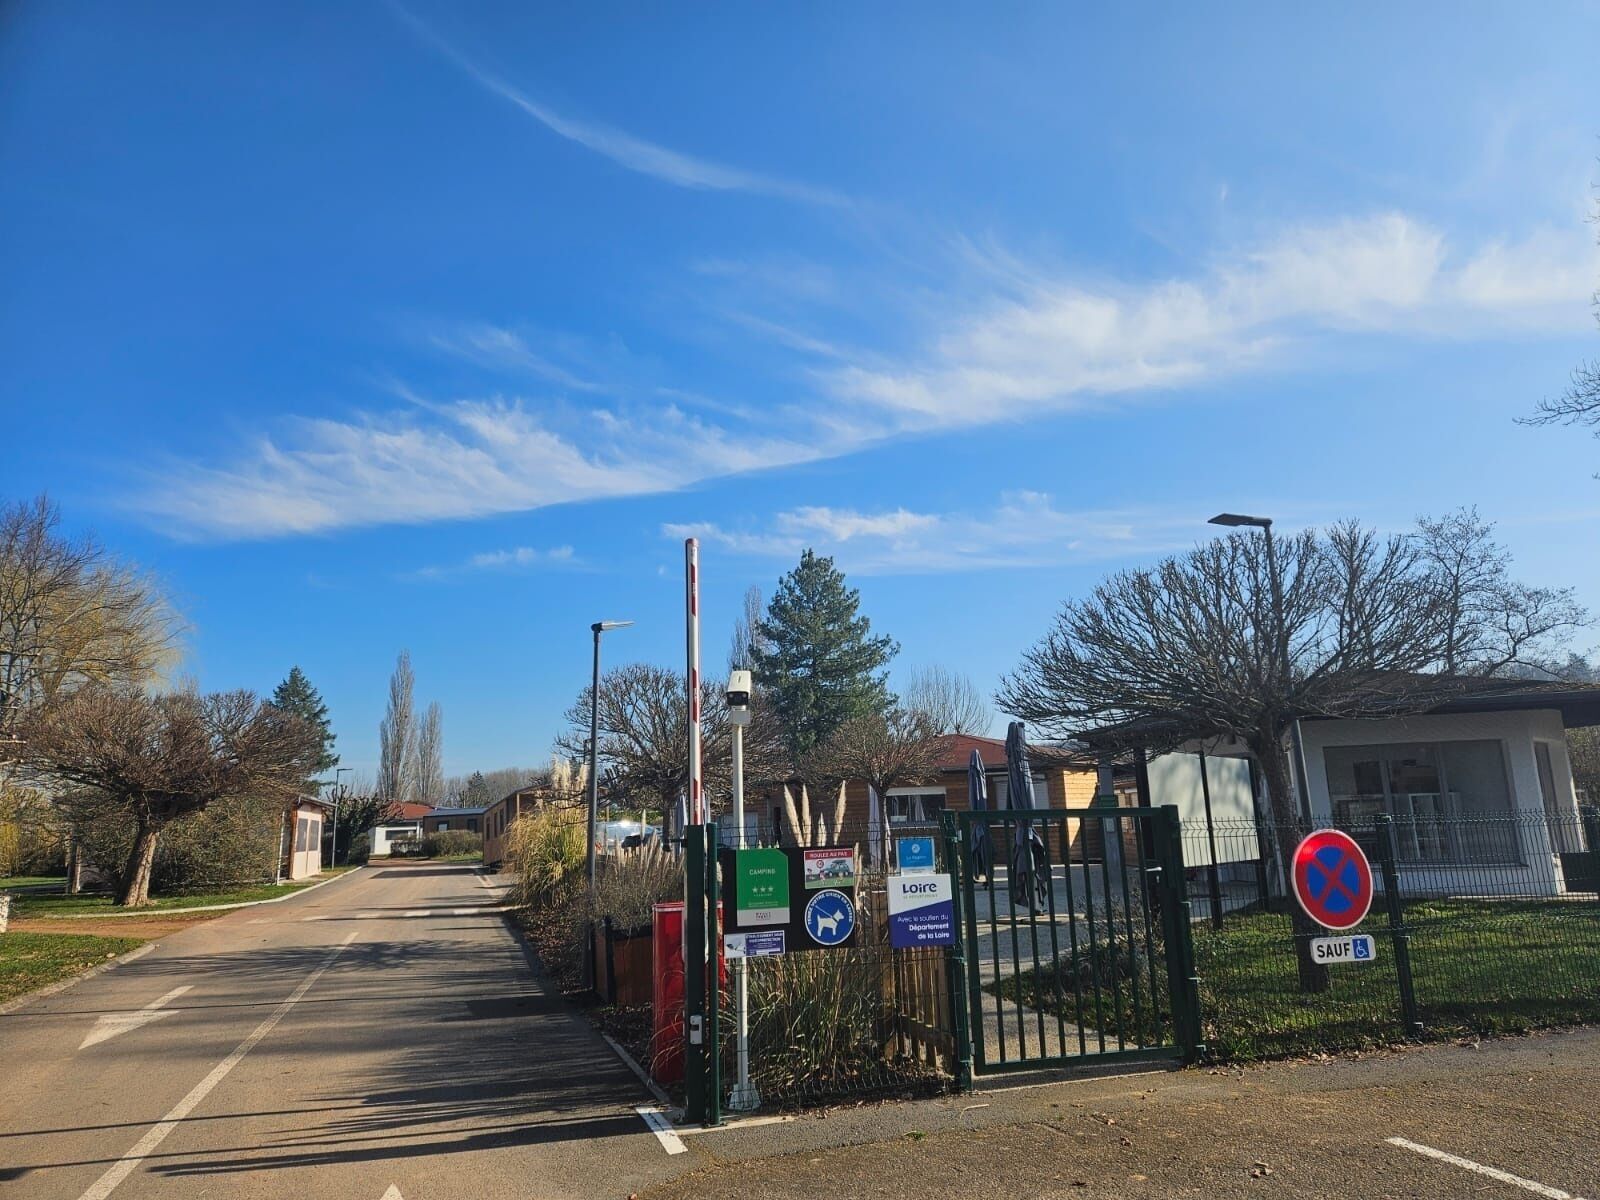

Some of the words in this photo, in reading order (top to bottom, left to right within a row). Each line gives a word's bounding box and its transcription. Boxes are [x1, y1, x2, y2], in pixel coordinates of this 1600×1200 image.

[749, 868, 776, 876] CAMPING
[902, 883, 937, 894] Loire
[909, 922, 949, 932] Département
[934, 931, 950, 939] Loire
[1316, 942, 1351, 958] SAUF
